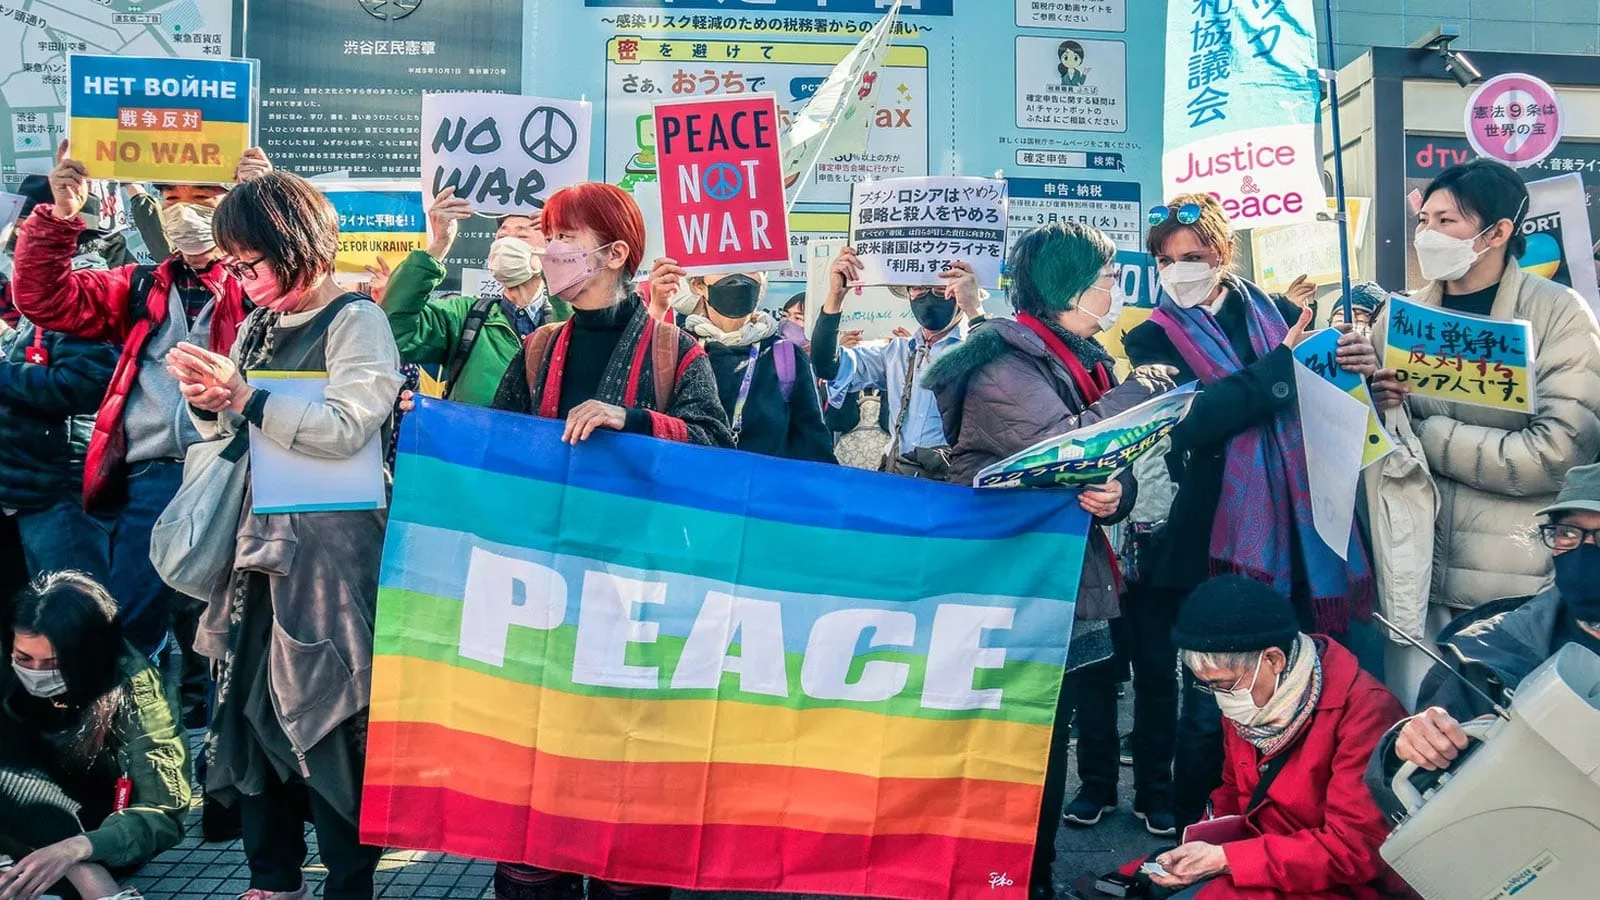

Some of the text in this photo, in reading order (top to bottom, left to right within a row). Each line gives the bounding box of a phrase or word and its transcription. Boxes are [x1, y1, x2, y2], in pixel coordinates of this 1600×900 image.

[1032, 12, 1089, 22] ご参照ください
[38, 41, 87, 51] 宇田川交番
[173, 34, 221, 44] 東急百貨店
[202, 46, 221, 55] 本店
[344, 40, 436, 56] 渋谷区民憲章
[84, 75, 236, 100] НЕТ ВОЙНЕ
[1026, 94, 1116, 105] 確定申告に関する疑問は
[17, 112, 37, 121] 渋谷
[120, 109, 200, 130] 戦争反対
[1473, 103, 1557, 120] 憲法9条は
[17, 124, 65, 133] 東武ホテル
[432, 116, 501, 155] NO
[662, 110, 771, 154] PEACE
[1484, 123, 1547, 137] 世界の宝
[96, 140, 221, 165] NO WAR
[1023, 152, 1116, 167] 確定申告 検索
[1416, 144, 1467, 168] dTV
[819, 163, 905, 174] 確定申告会場に行かずに
[1176, 142, 1295, 183] Justice
[432, 166, 545, 209] WAR
[1044, 182, 1102, 198] 申告・納税
[1240, 175, 1261, 194] &
[858, 206, 999, 225] 侵略と殺人をやめろ
[678, 210, 773, 254] WAR
[350, 241, 368, 252] FOR
[369, 240, 414, 252] UKRAINE
[856, 241, 1001, 257] 欧米諸国はウクライナを
[886, 259, 960, 273] 「利用」する
[1392, 308, 1524, 358] 私は戦争に
[1408, 344, 1514, 378] 反対する
[1395, 369, 1525, 403] ロシア人です。
[458, 547, 1016, 710] PEACE
